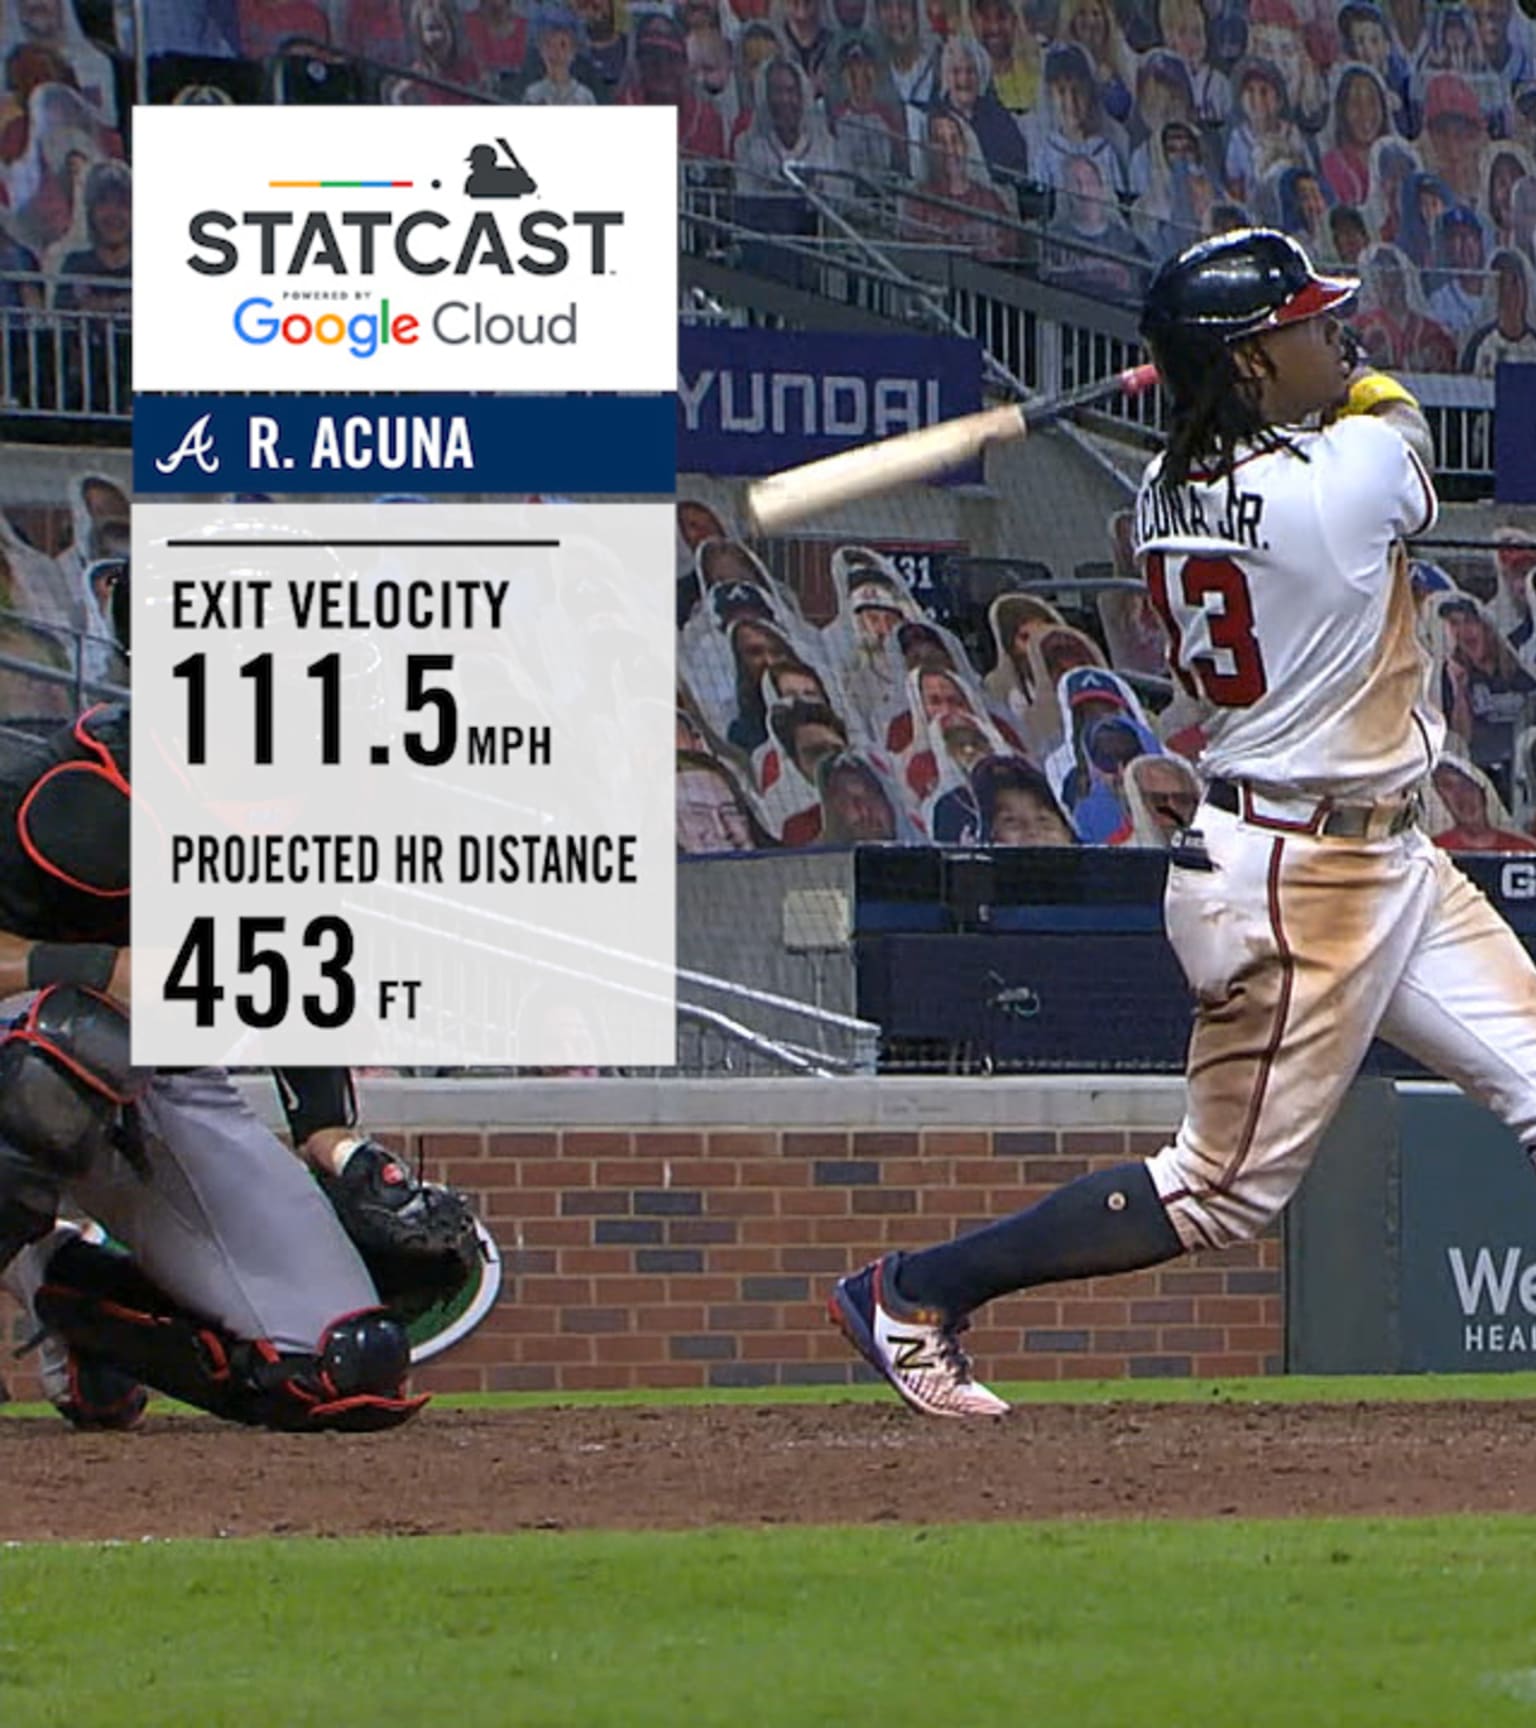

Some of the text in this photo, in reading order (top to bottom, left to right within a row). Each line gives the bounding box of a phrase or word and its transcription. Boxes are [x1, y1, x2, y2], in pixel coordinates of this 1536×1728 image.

[677, 370, 940, 435] YUNDAI
[1136, 482, 1269, 550] CUNA JR.
[1146, 552, 1269, 708] 13
